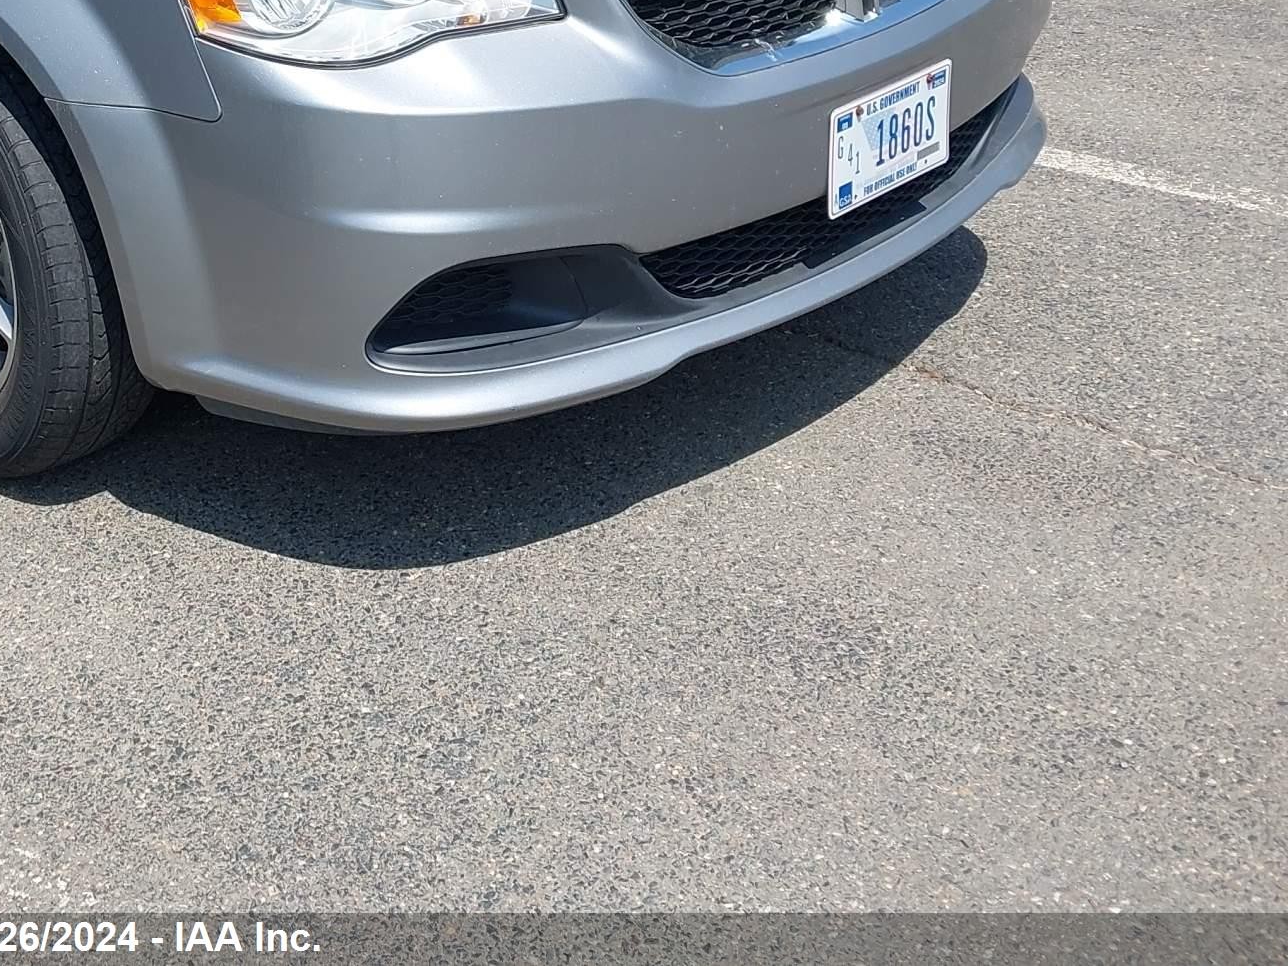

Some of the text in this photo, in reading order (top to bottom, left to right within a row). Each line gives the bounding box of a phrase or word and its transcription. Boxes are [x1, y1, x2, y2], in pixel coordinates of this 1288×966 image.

[880, 81, 920, 110] GOVERNMENT
[875, 95, 936, 166] 1860S
[863, 183, 873, 196] FOR
[874, 171, 895, 191] OFFICIAL
[896, 166, 905, 180] USE
